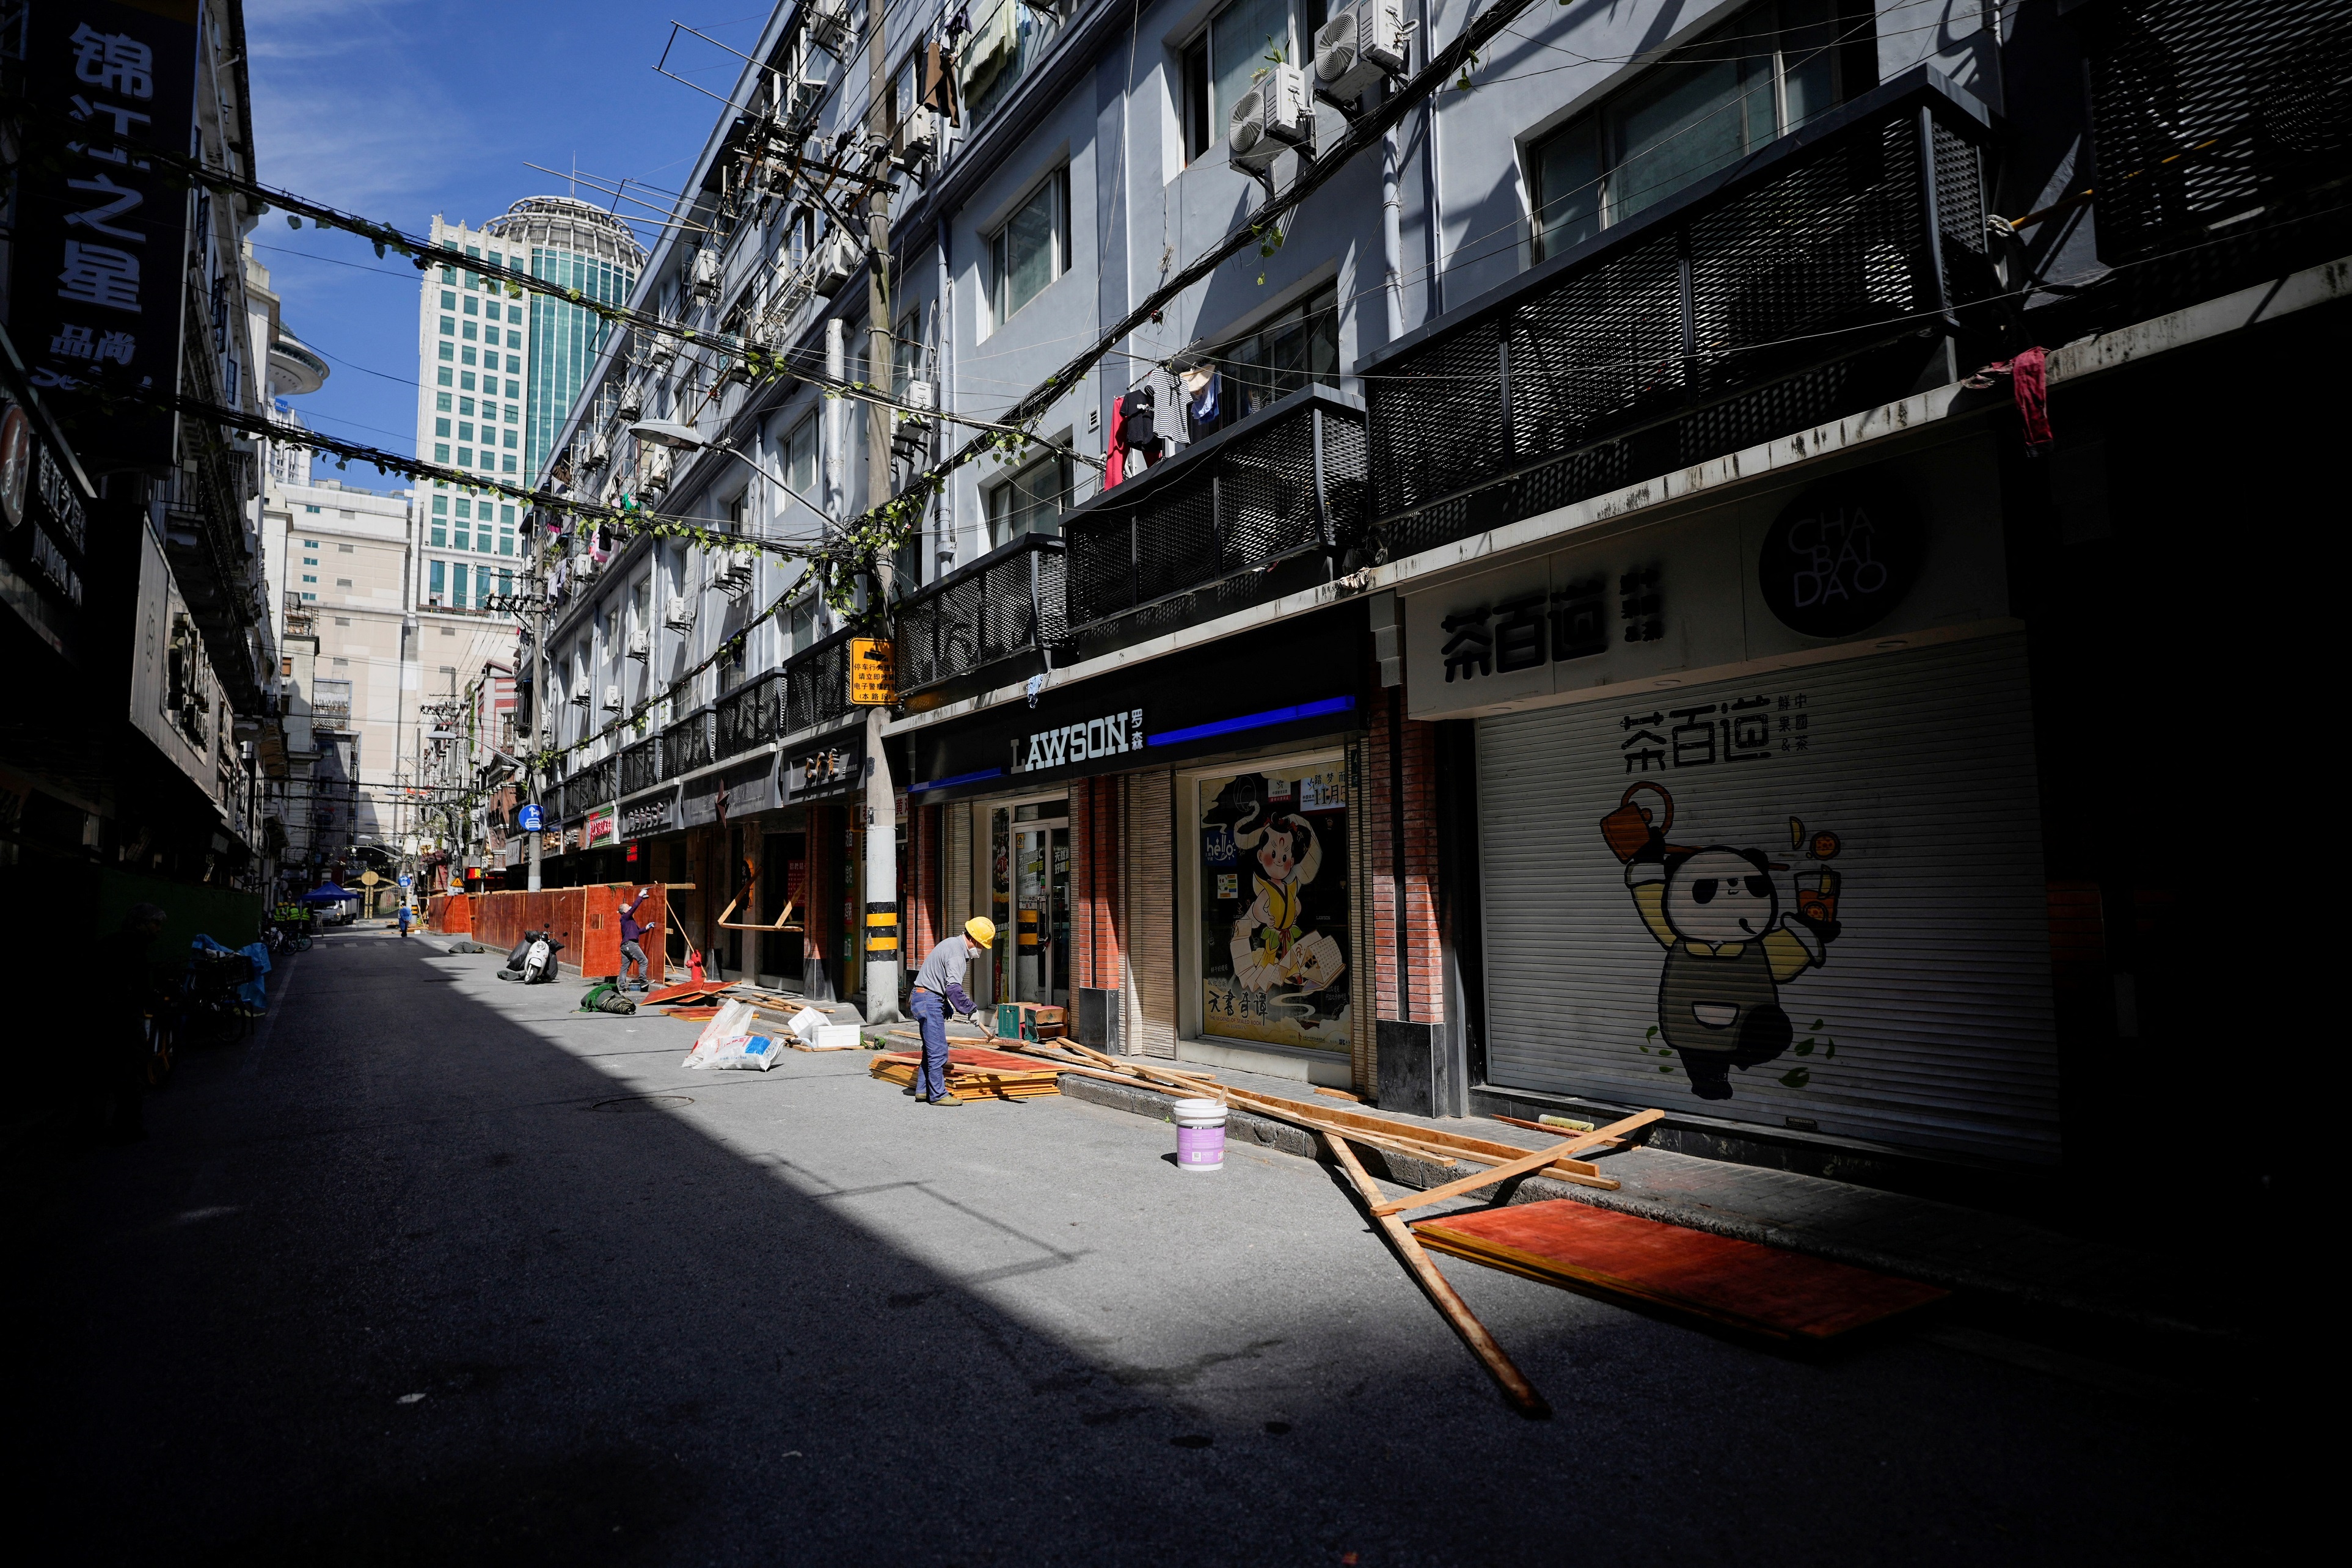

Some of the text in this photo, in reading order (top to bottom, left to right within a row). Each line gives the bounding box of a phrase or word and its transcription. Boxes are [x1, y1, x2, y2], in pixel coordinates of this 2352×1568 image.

[57, 21, 154, 315] 锦江之星
[49, 323, 136, 366] 品尚
[1788, 506, 1875, 555] CHA
[1812, 534, 1872, 577] BAI
[1793, 560, 1887, 608] DAO
[1010, 712, 1129, 775] LAWSON
[1131, 708, 1144, 751] 罗森
